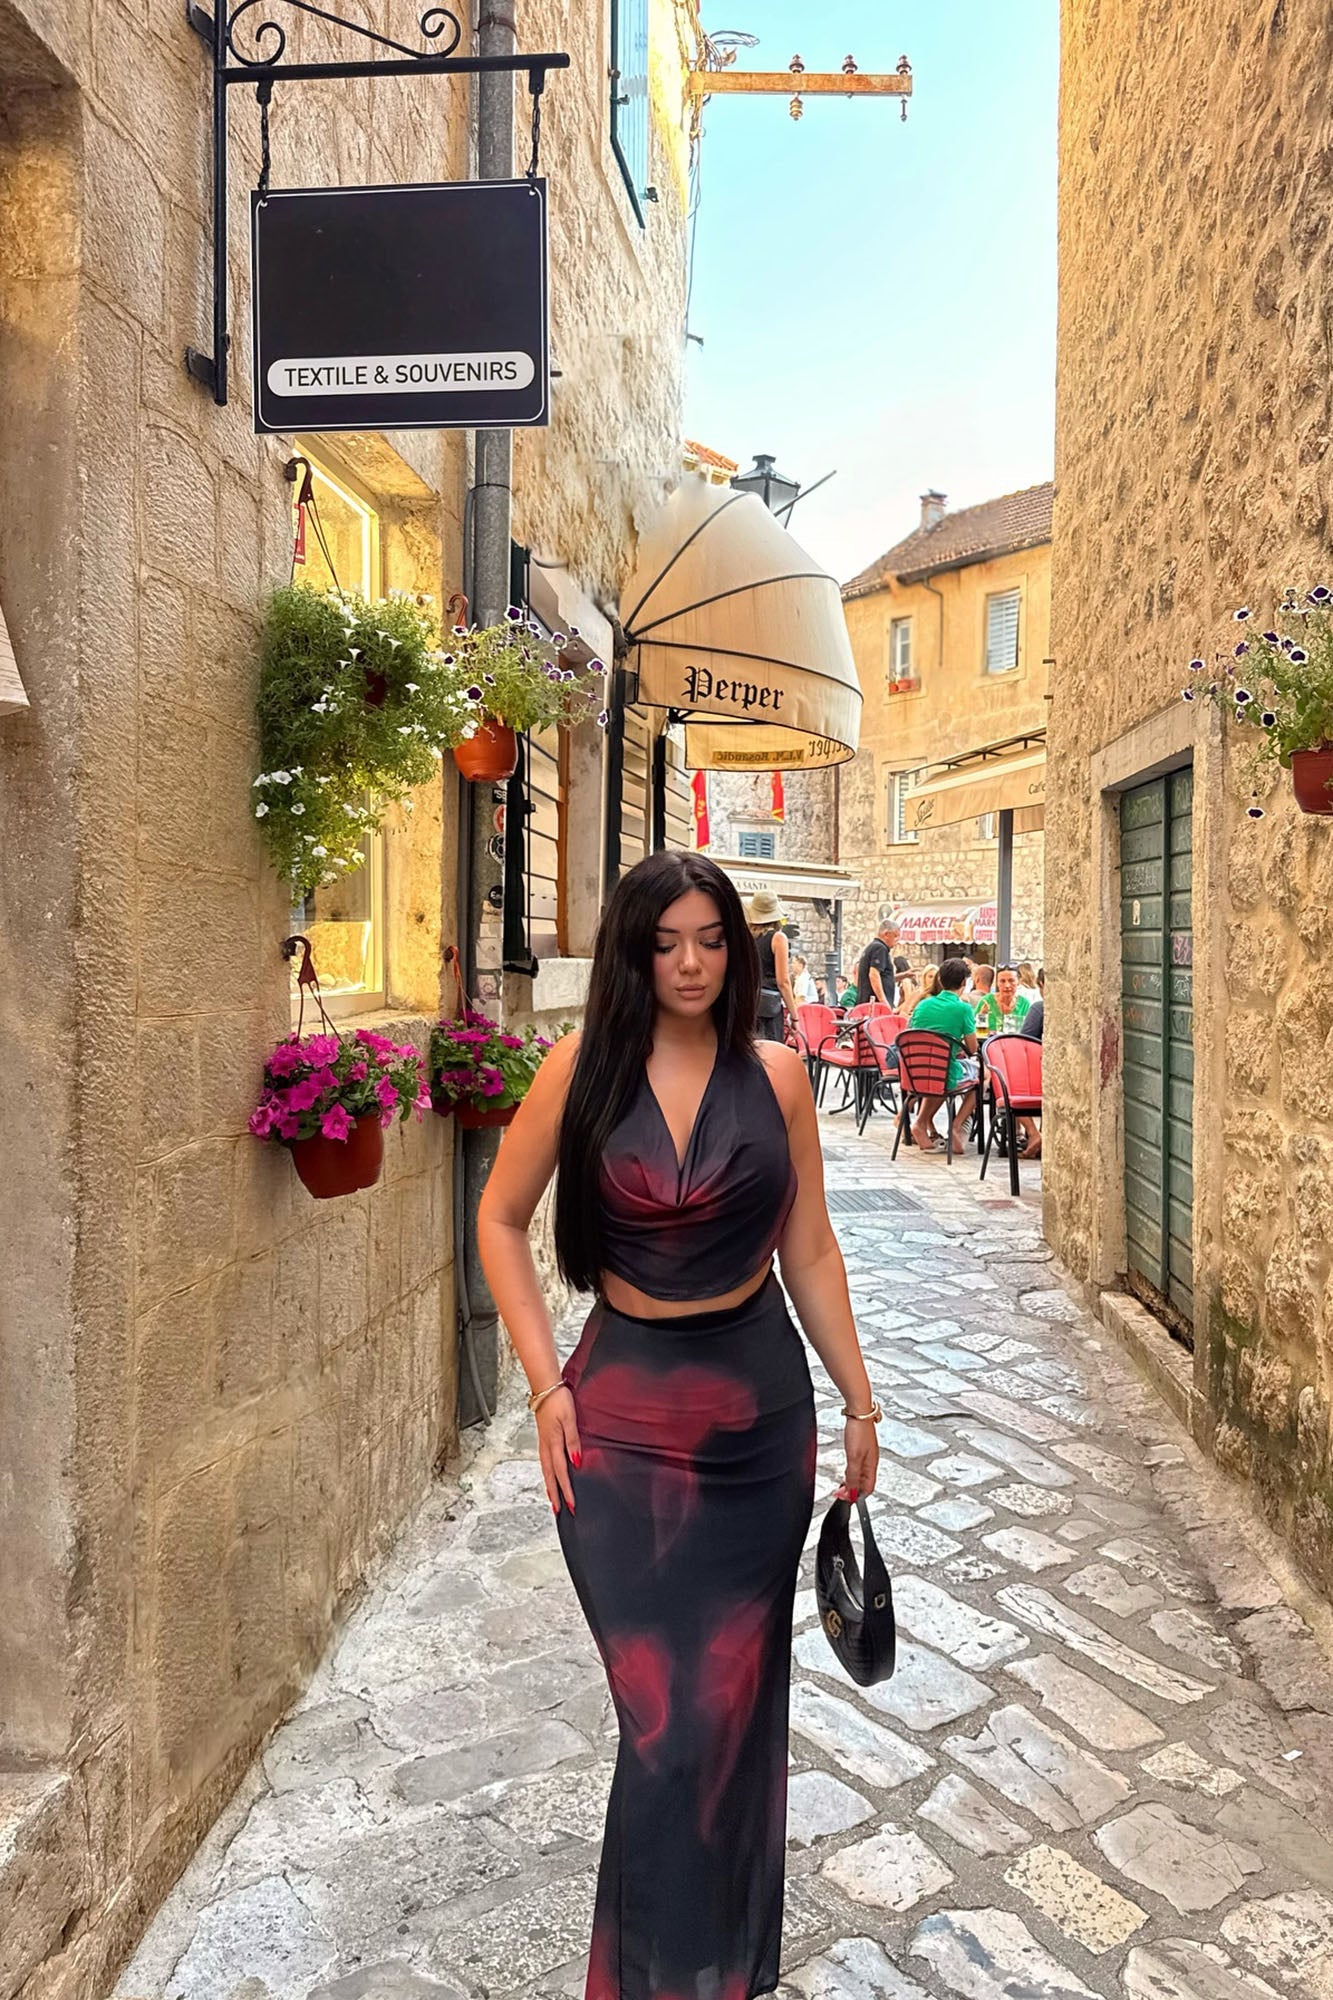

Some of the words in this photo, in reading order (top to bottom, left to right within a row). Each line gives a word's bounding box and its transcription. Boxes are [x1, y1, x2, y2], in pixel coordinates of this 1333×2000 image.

[284, 365, 368, 388] TEXTILE
[373, 365, 389, 384] &
[395, 360, 518, 383] SOUVENIRS
[681, 665, 785, 711] Perper
[900, 917, 957, 928] MARKET
